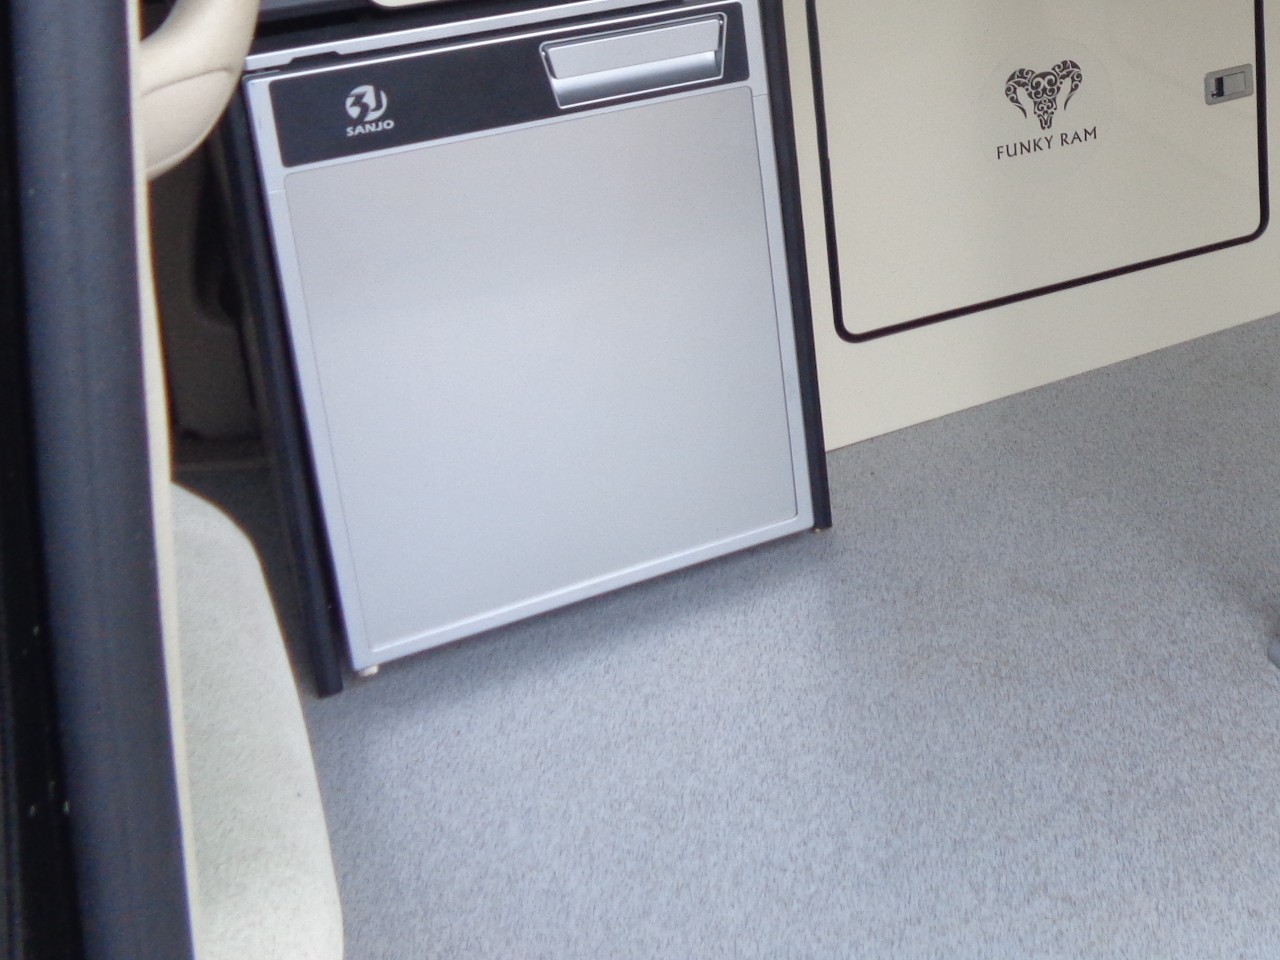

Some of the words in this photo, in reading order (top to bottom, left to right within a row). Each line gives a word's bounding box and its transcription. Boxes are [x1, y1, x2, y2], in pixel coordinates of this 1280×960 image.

[346, 119, 395, 137] SANJO
[996, 135, 1054, 160] FUNKY
[1060, 126, 1098, 147] RAM
